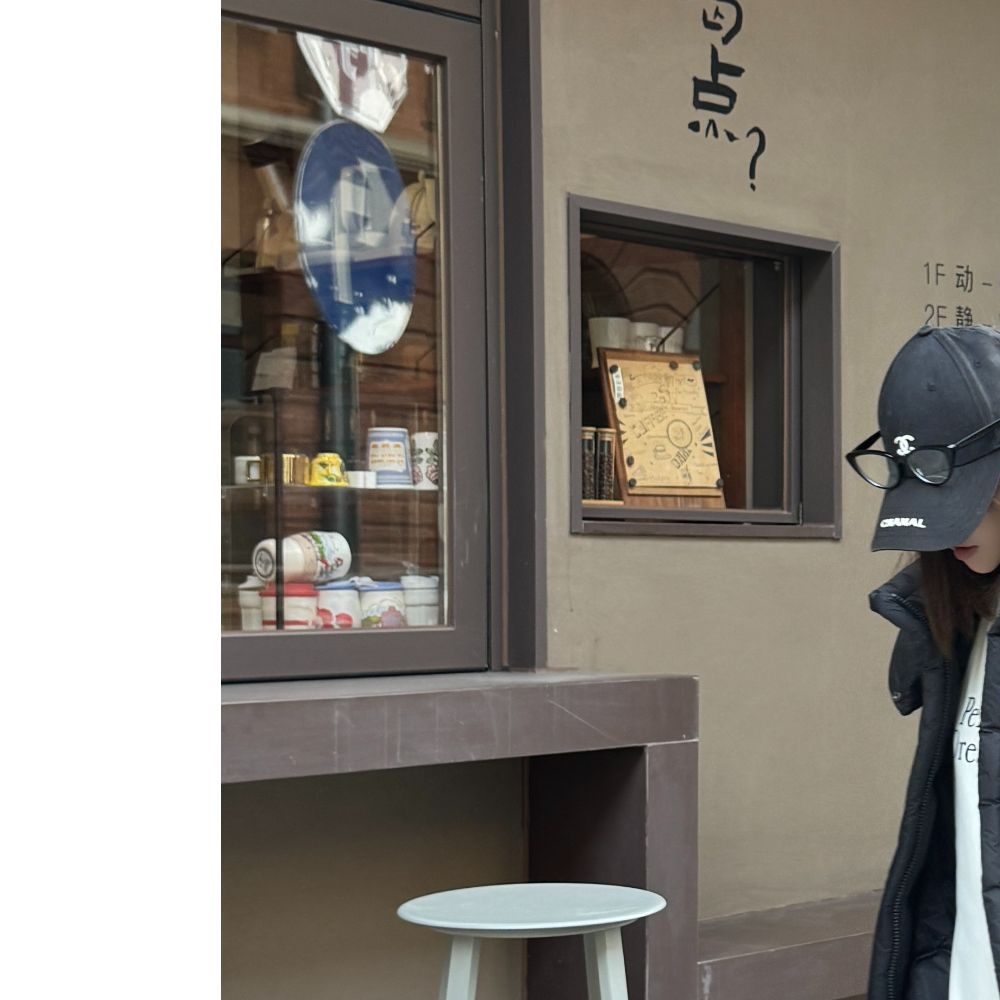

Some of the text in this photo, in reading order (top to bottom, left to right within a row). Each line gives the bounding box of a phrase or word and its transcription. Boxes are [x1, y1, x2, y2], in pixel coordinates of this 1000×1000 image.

[924, 262, 946, 286] 1F
[956, 265, 974, 293] 动
[924, 304, 947, 327] 2F
